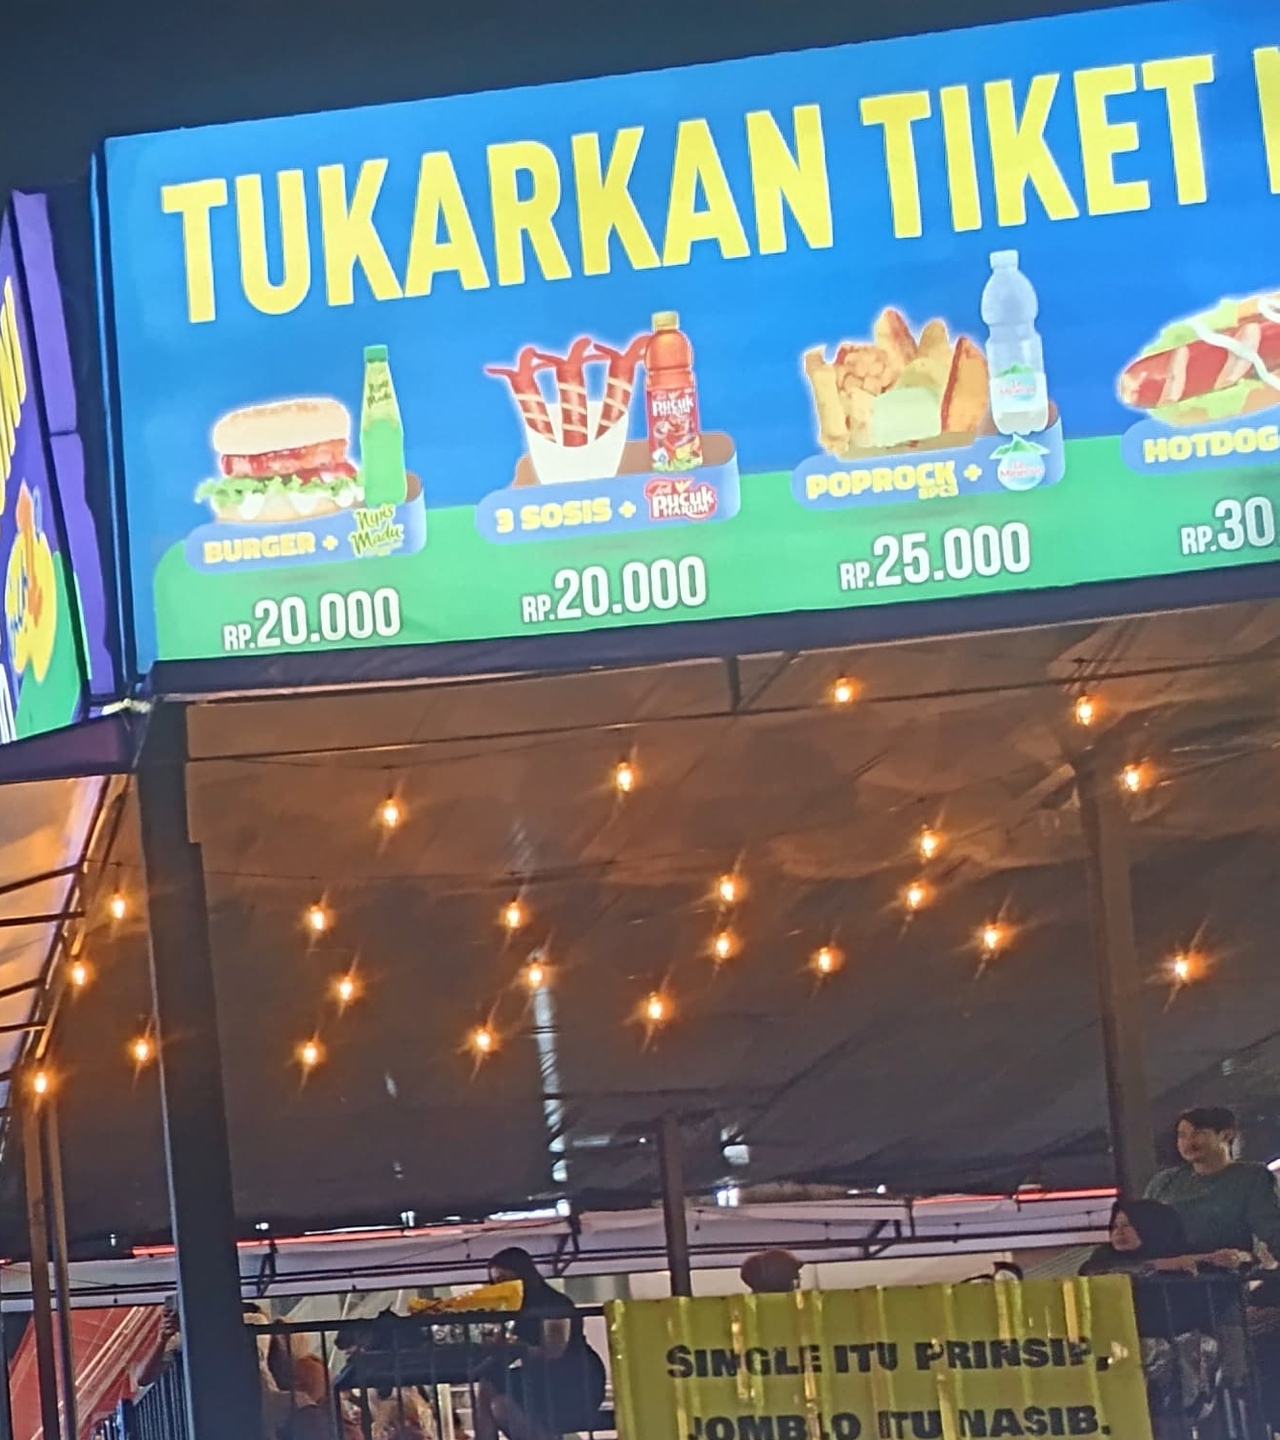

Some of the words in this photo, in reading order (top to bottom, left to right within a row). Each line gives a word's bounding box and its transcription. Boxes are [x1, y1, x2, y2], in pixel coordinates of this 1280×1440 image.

[161, 104, 834, 324] TUKARKAN
[859, 54, 1215, 239] TIKET
[1143, 425, 1280, 464] HOTDOG
[805, 460, 956, 500] POPROCK
[495, 508, 514, 533] 3
[521, 497, 612, 530] SOSIS
[203, 532, 316, 565] BURGER
[350, 524, 405, 554] Madu
[666, 1342, 823, 1379] SINGLE
[833, 1341, 899, 1374] ITU
[879, 1406, 941, 1440] ITU
[958, 1404, 1112, 1439] NASIB.
